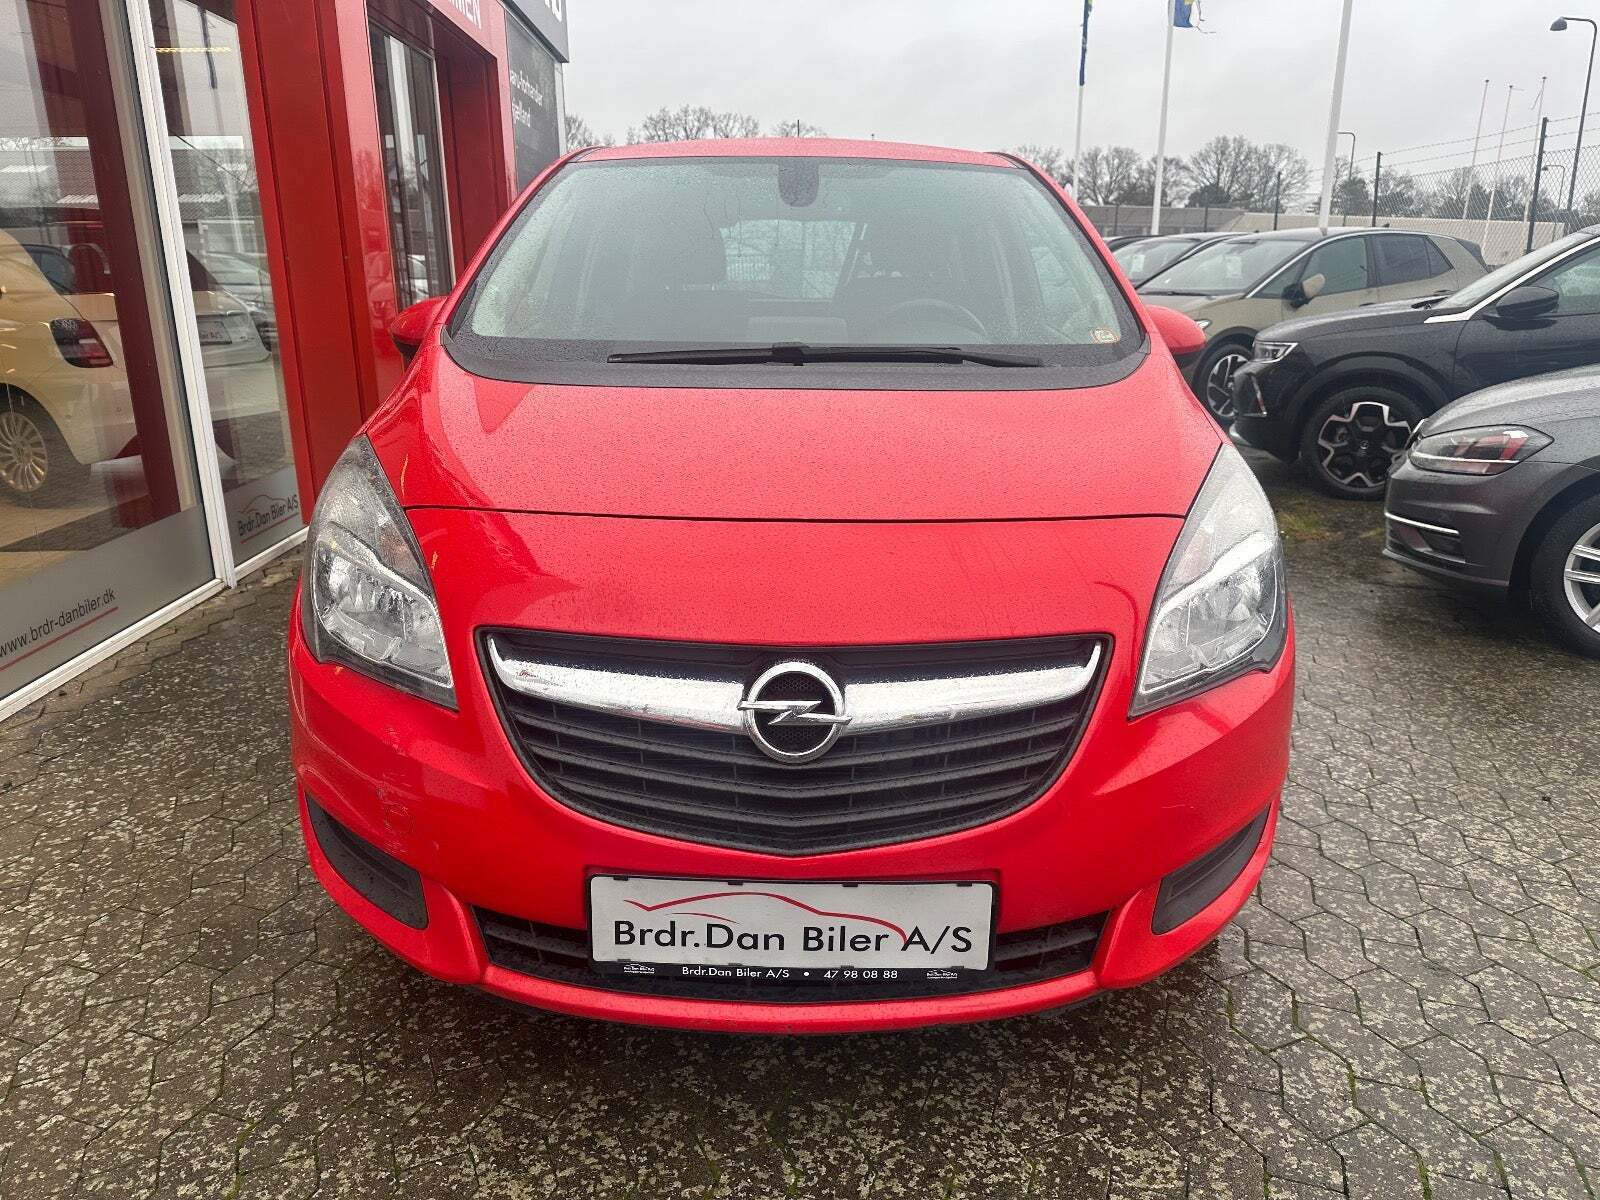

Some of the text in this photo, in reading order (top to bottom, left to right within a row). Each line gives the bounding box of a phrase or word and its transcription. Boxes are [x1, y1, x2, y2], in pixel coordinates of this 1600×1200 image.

[614, 920, 972, 955] Brdr.Dan Biler A/S
[682, 966, 898, 979] Brdr.Dan Biler A/S 47 98 08 88
